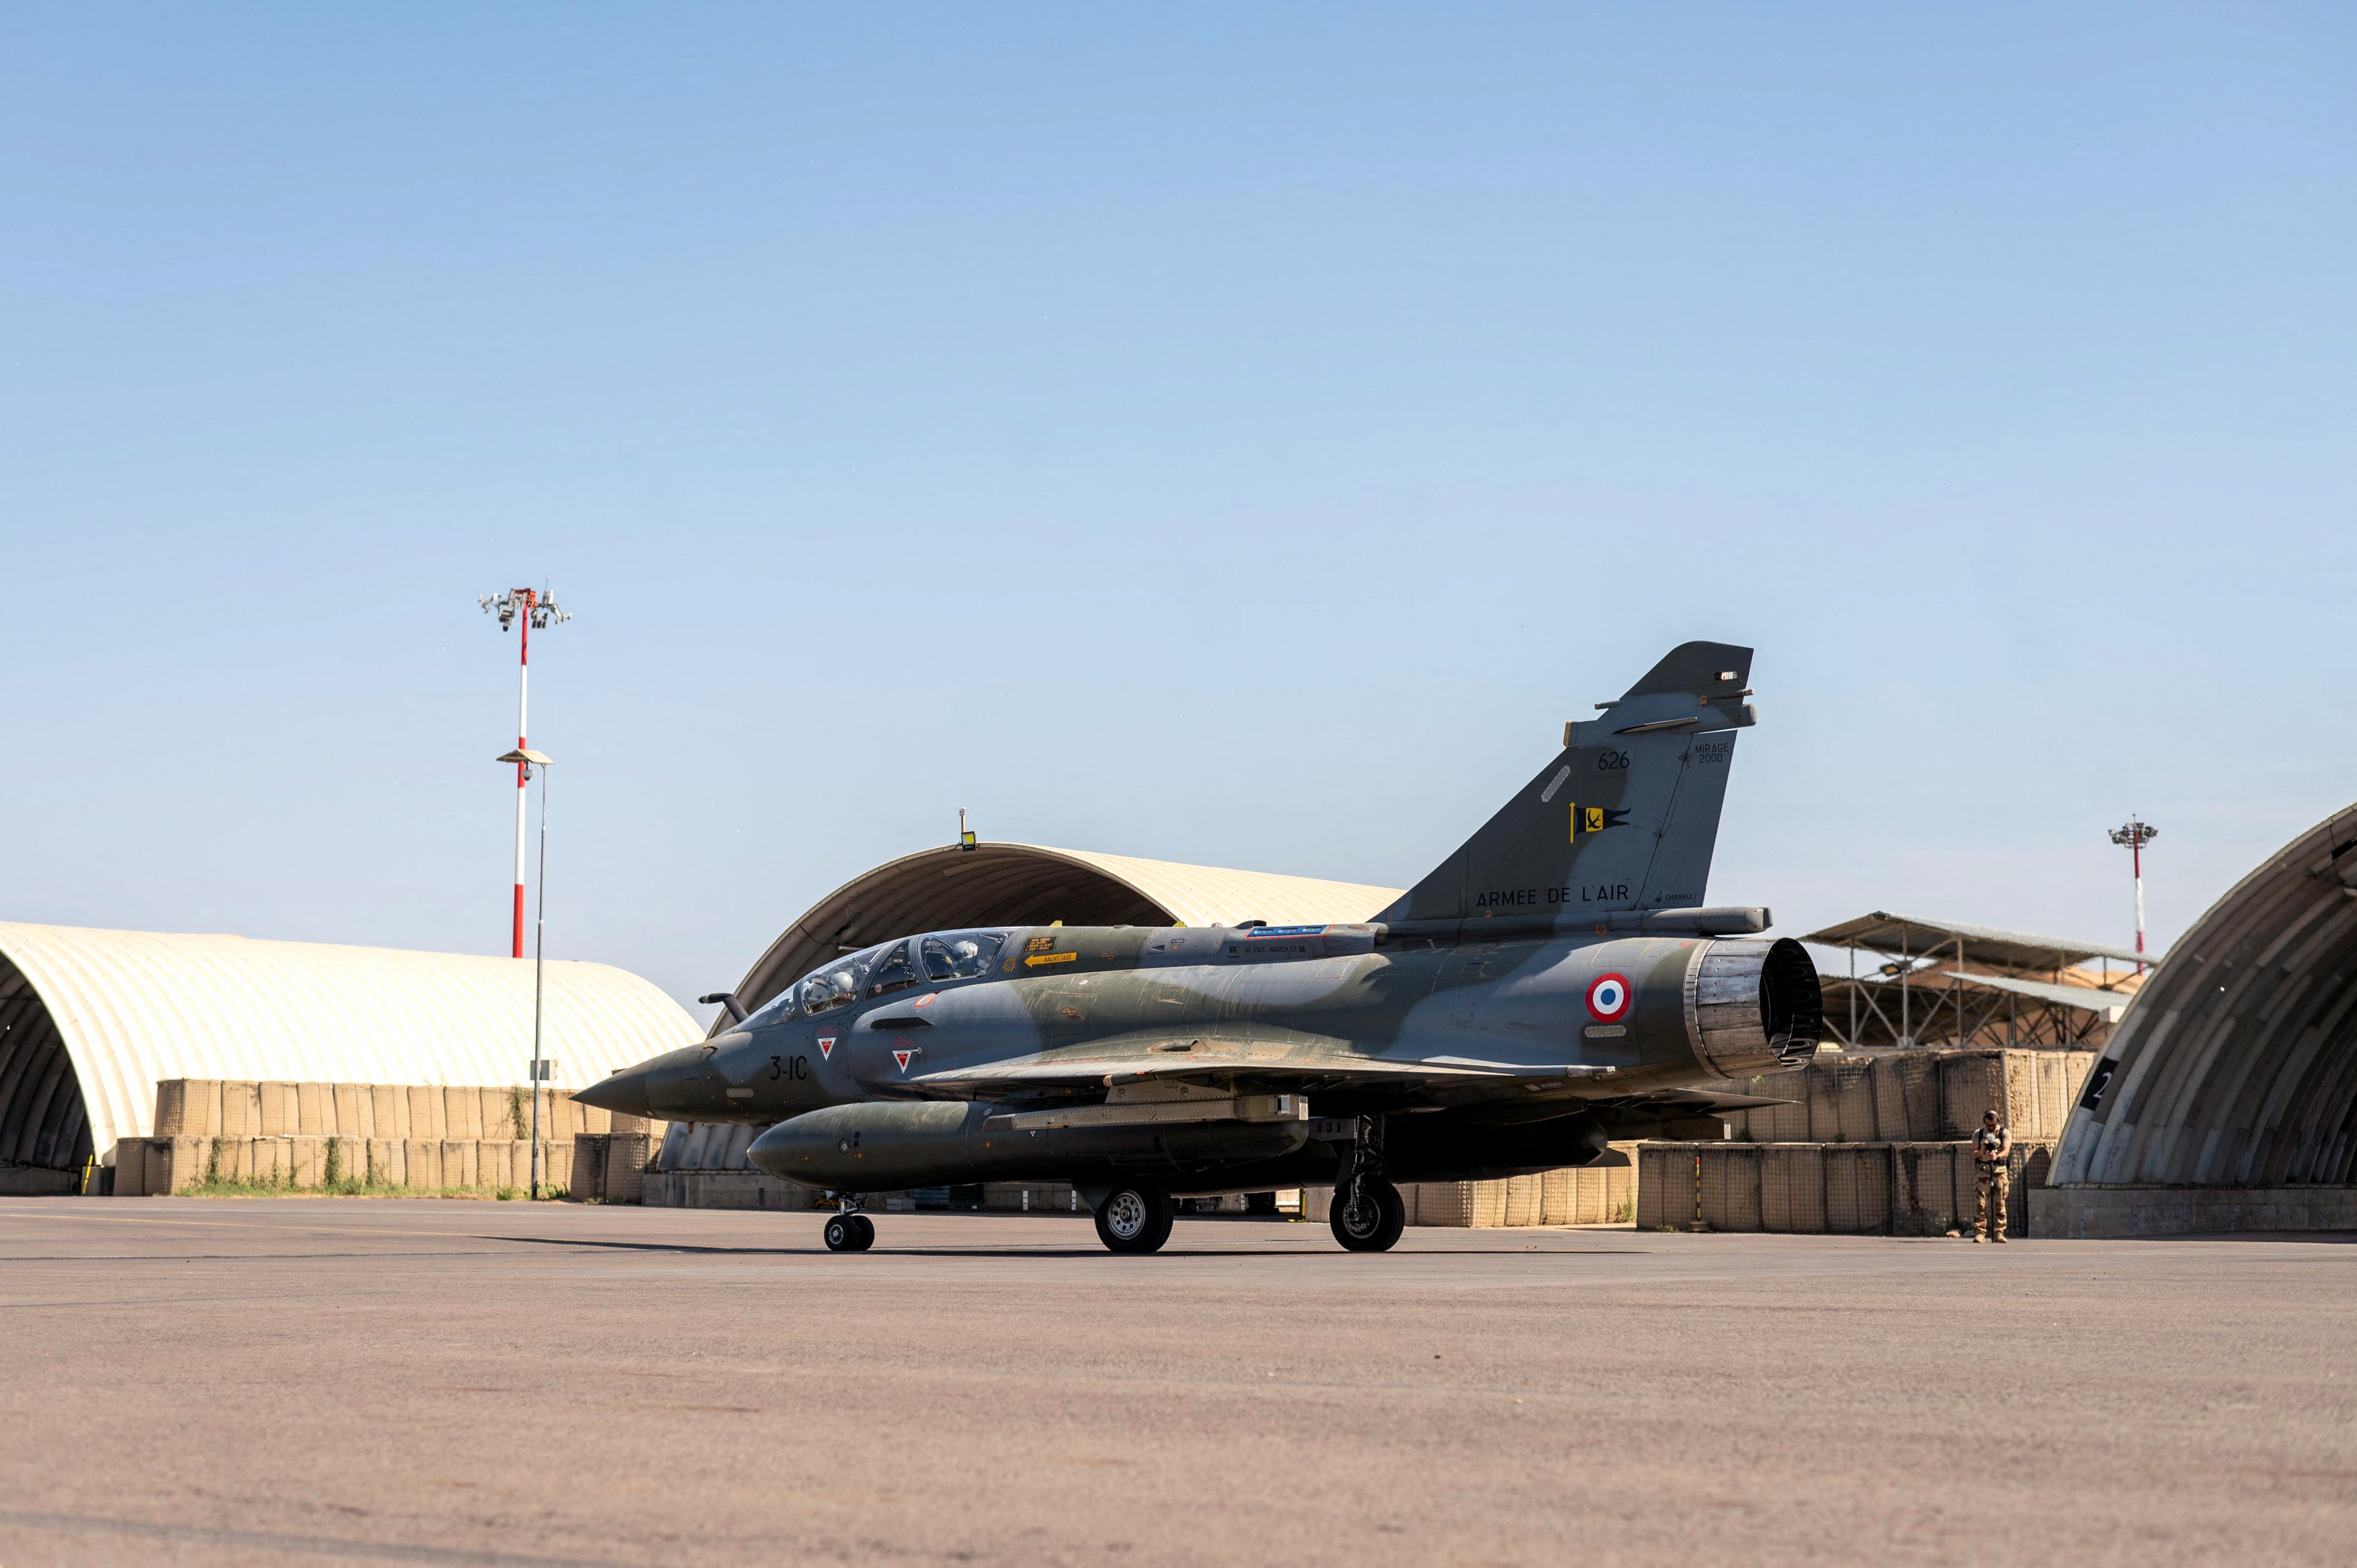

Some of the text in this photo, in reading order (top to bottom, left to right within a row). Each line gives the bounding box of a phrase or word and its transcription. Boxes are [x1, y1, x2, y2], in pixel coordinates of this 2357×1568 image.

[1695, 743, 1729, 754] MIRAGE
[1598, 751, 1630, 770] 626
[1699, 753, 1723, 763] 2000
[1477, 885, 1628, 907] ARMEE DE L'AIR
[1044, 954, 1072, 962] SAUVETAGE
[2093, 1071, 2112, 1098] 2
